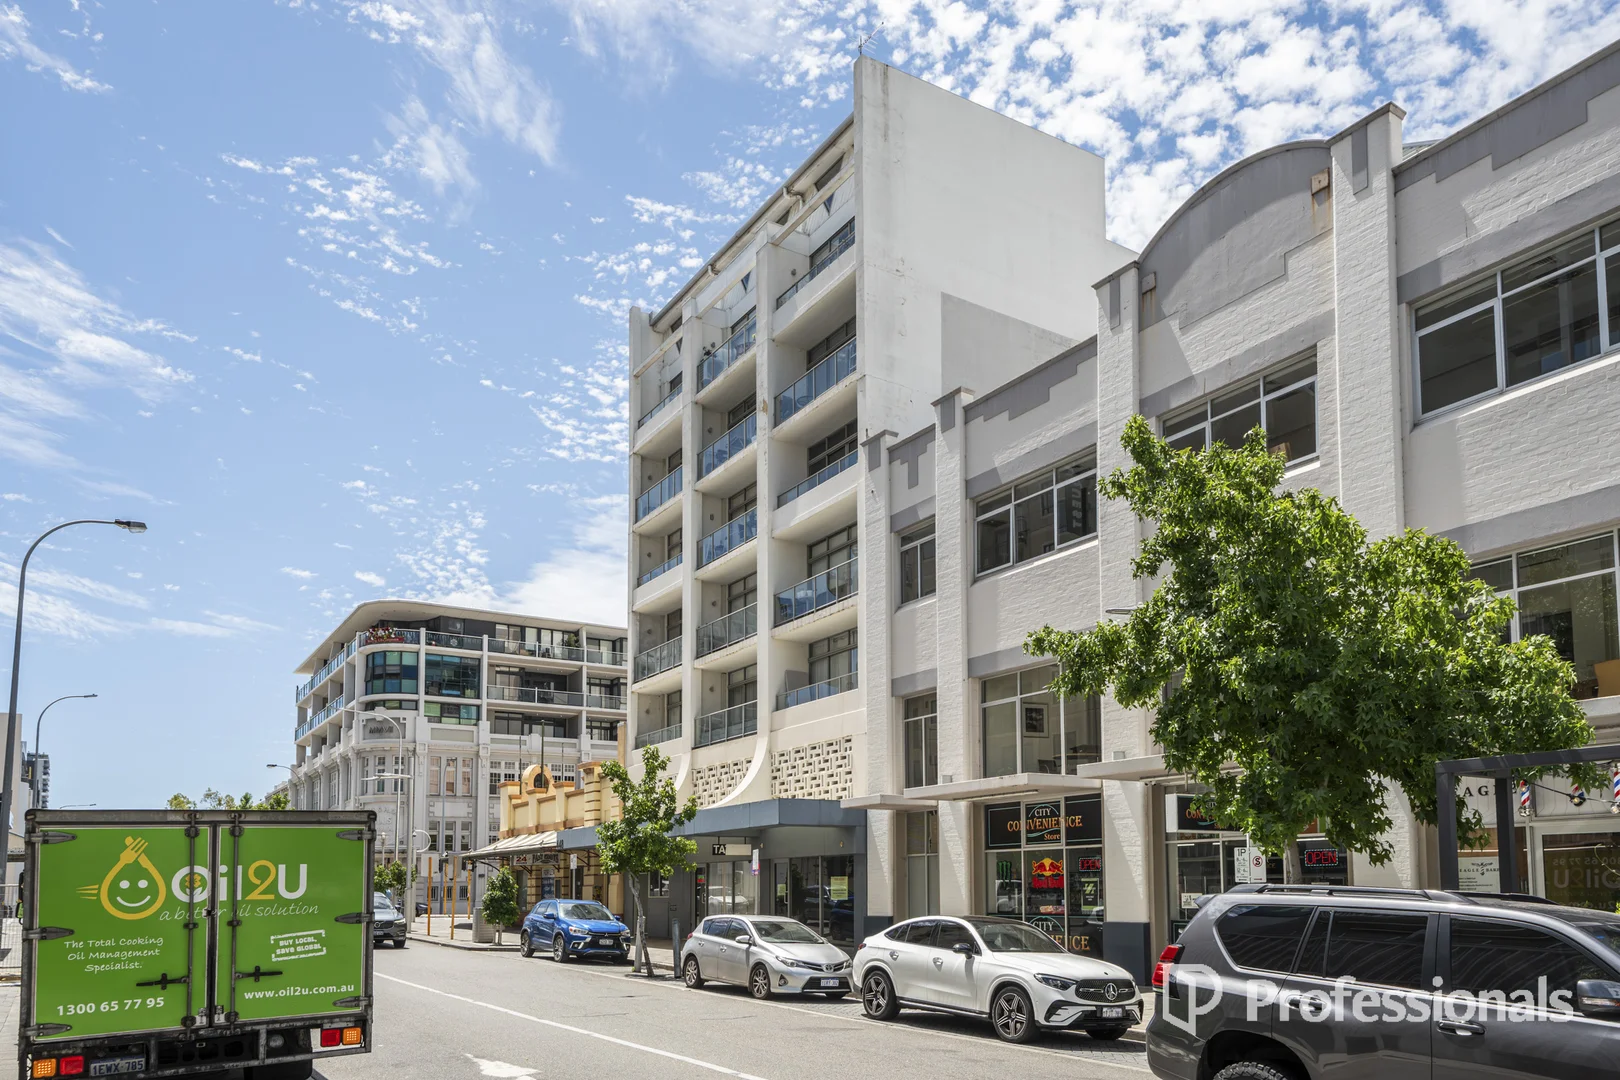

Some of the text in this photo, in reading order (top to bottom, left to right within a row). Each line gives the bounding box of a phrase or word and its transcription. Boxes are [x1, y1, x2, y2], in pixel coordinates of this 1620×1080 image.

[1034, 807, 1052, 817] CITY
[1237, 848, 1247, 857] 1P
[1305, 851, 1337, 865] OPEN
[1080, 859, 1101, 870] OPEN
[171, 859, 308, 903] Oil2U
[159, 911, 171, 921] a
[254, 902, 319, 917] solution
[64, 935, 164, 949] The Total Cooking
[279, 939, 294, 947] BUY
[67, 948, 160, 961] Oil Management
[84, 961, 143, 974] Specialist.
[244, 984, 355, 999] www.oil2u.com.au
[57, 997, 165, 1016] 1300 65 77 95
